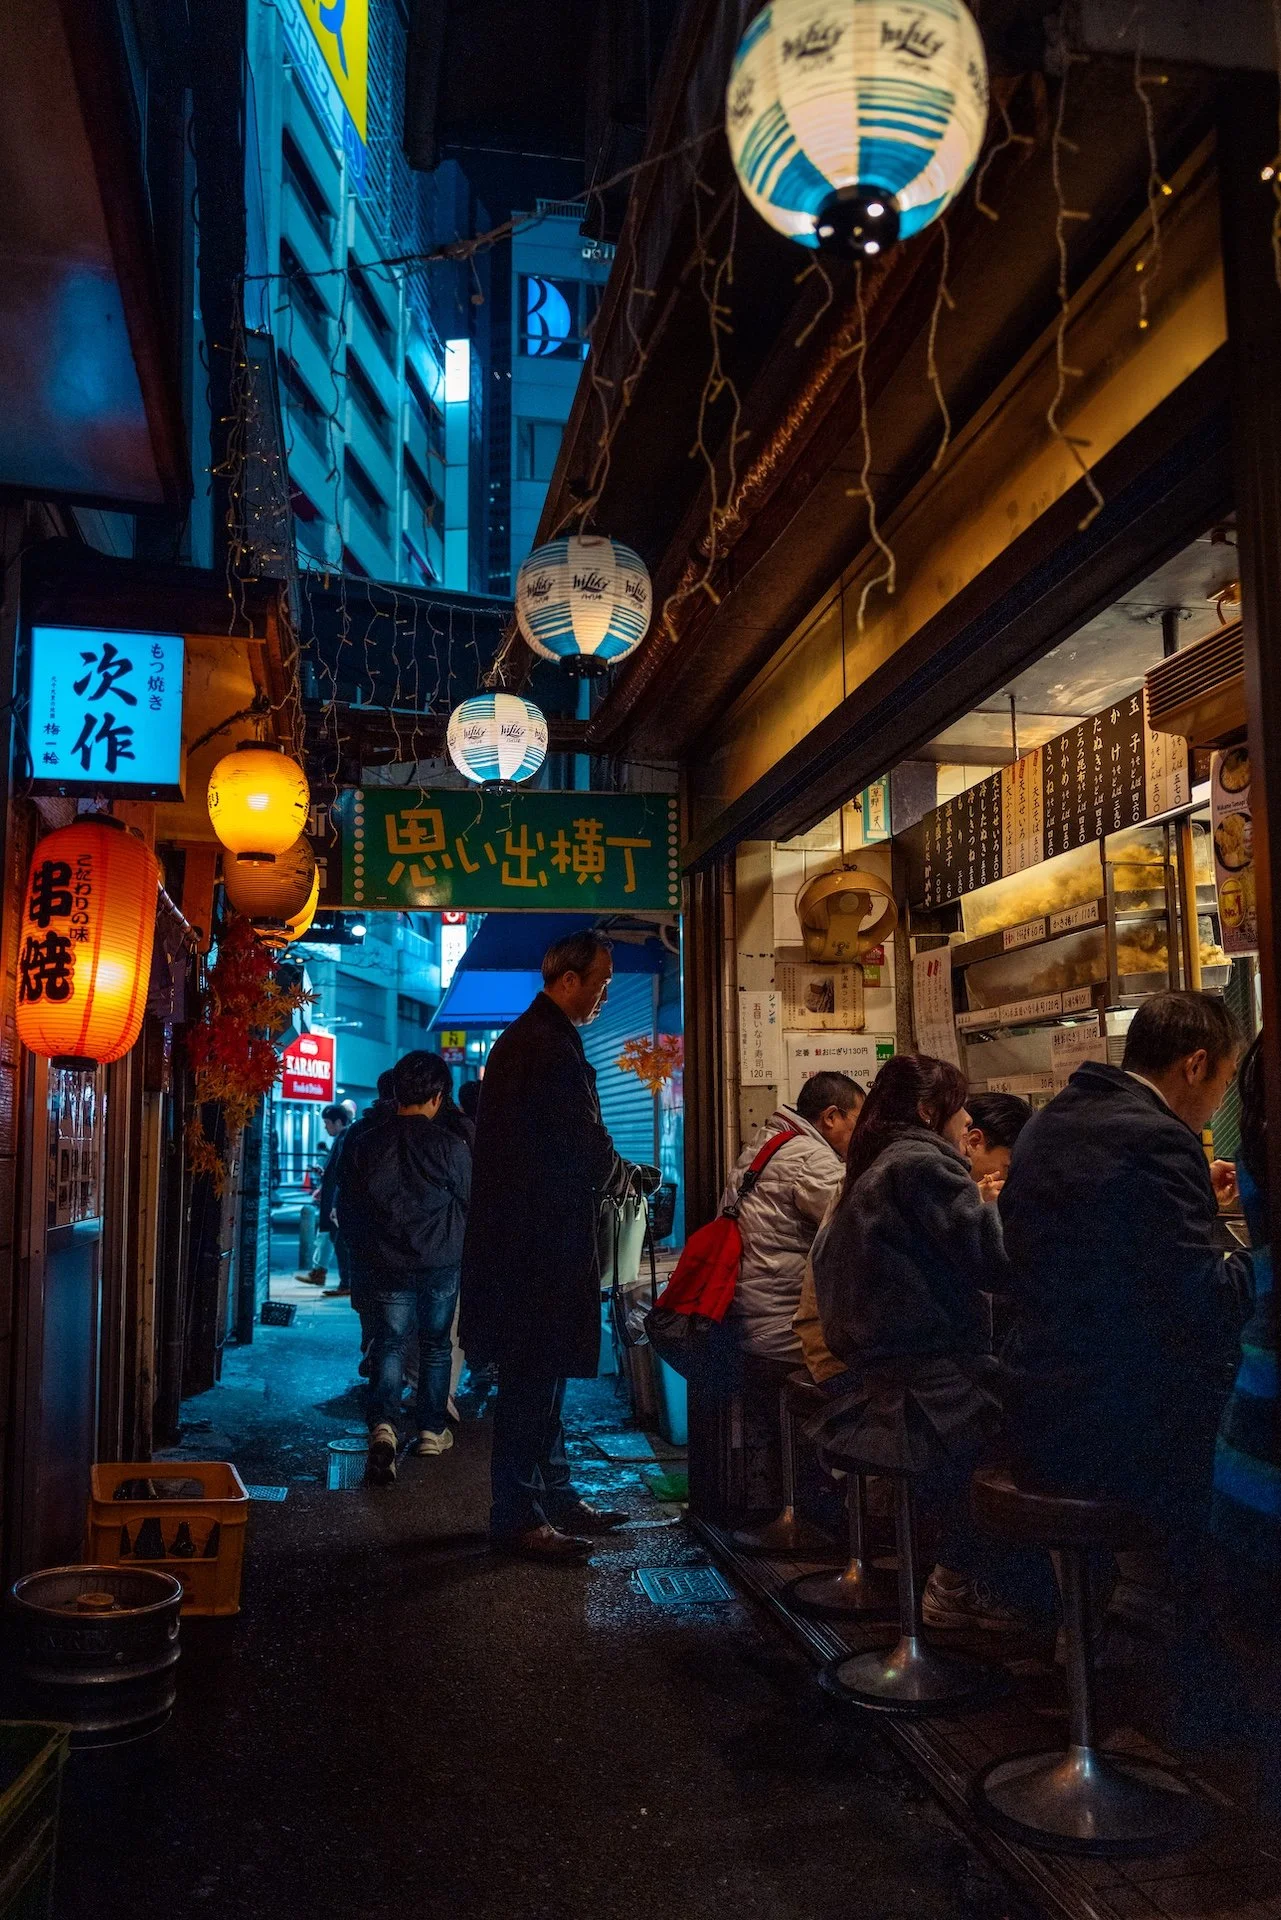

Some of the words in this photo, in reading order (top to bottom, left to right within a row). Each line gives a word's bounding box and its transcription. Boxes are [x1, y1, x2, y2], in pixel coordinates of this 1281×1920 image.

[147, 643, 165, 711] もつ焼き
[71, 642, 137, 774] 次作
[1110, 708, 1121, 763] かけ
[1128, 696, 1142, 755] 玉子
[42, 723, 61, 765] 梅一輪
[1060, 740, 1070, 787] わかめ
[1076, 726, 1087, 783] とろろ昆布
[1092, 717, 1103, 772] たぬき
[386, 808, 653, 893] 思い出横丁
[70, 854, 93, 943] こだわりの味
[1052, 912, 1079, 929] かき揚げ
[1081, 905, 1097, 921] 110円
[19, 860, 73, 1003] 串焼
[753, 1003, 764, 1069] 五目いなり寿司
[795, 1048, 810, 1057] 定番
[286, 1055, 331, 1080] KARAOKE
